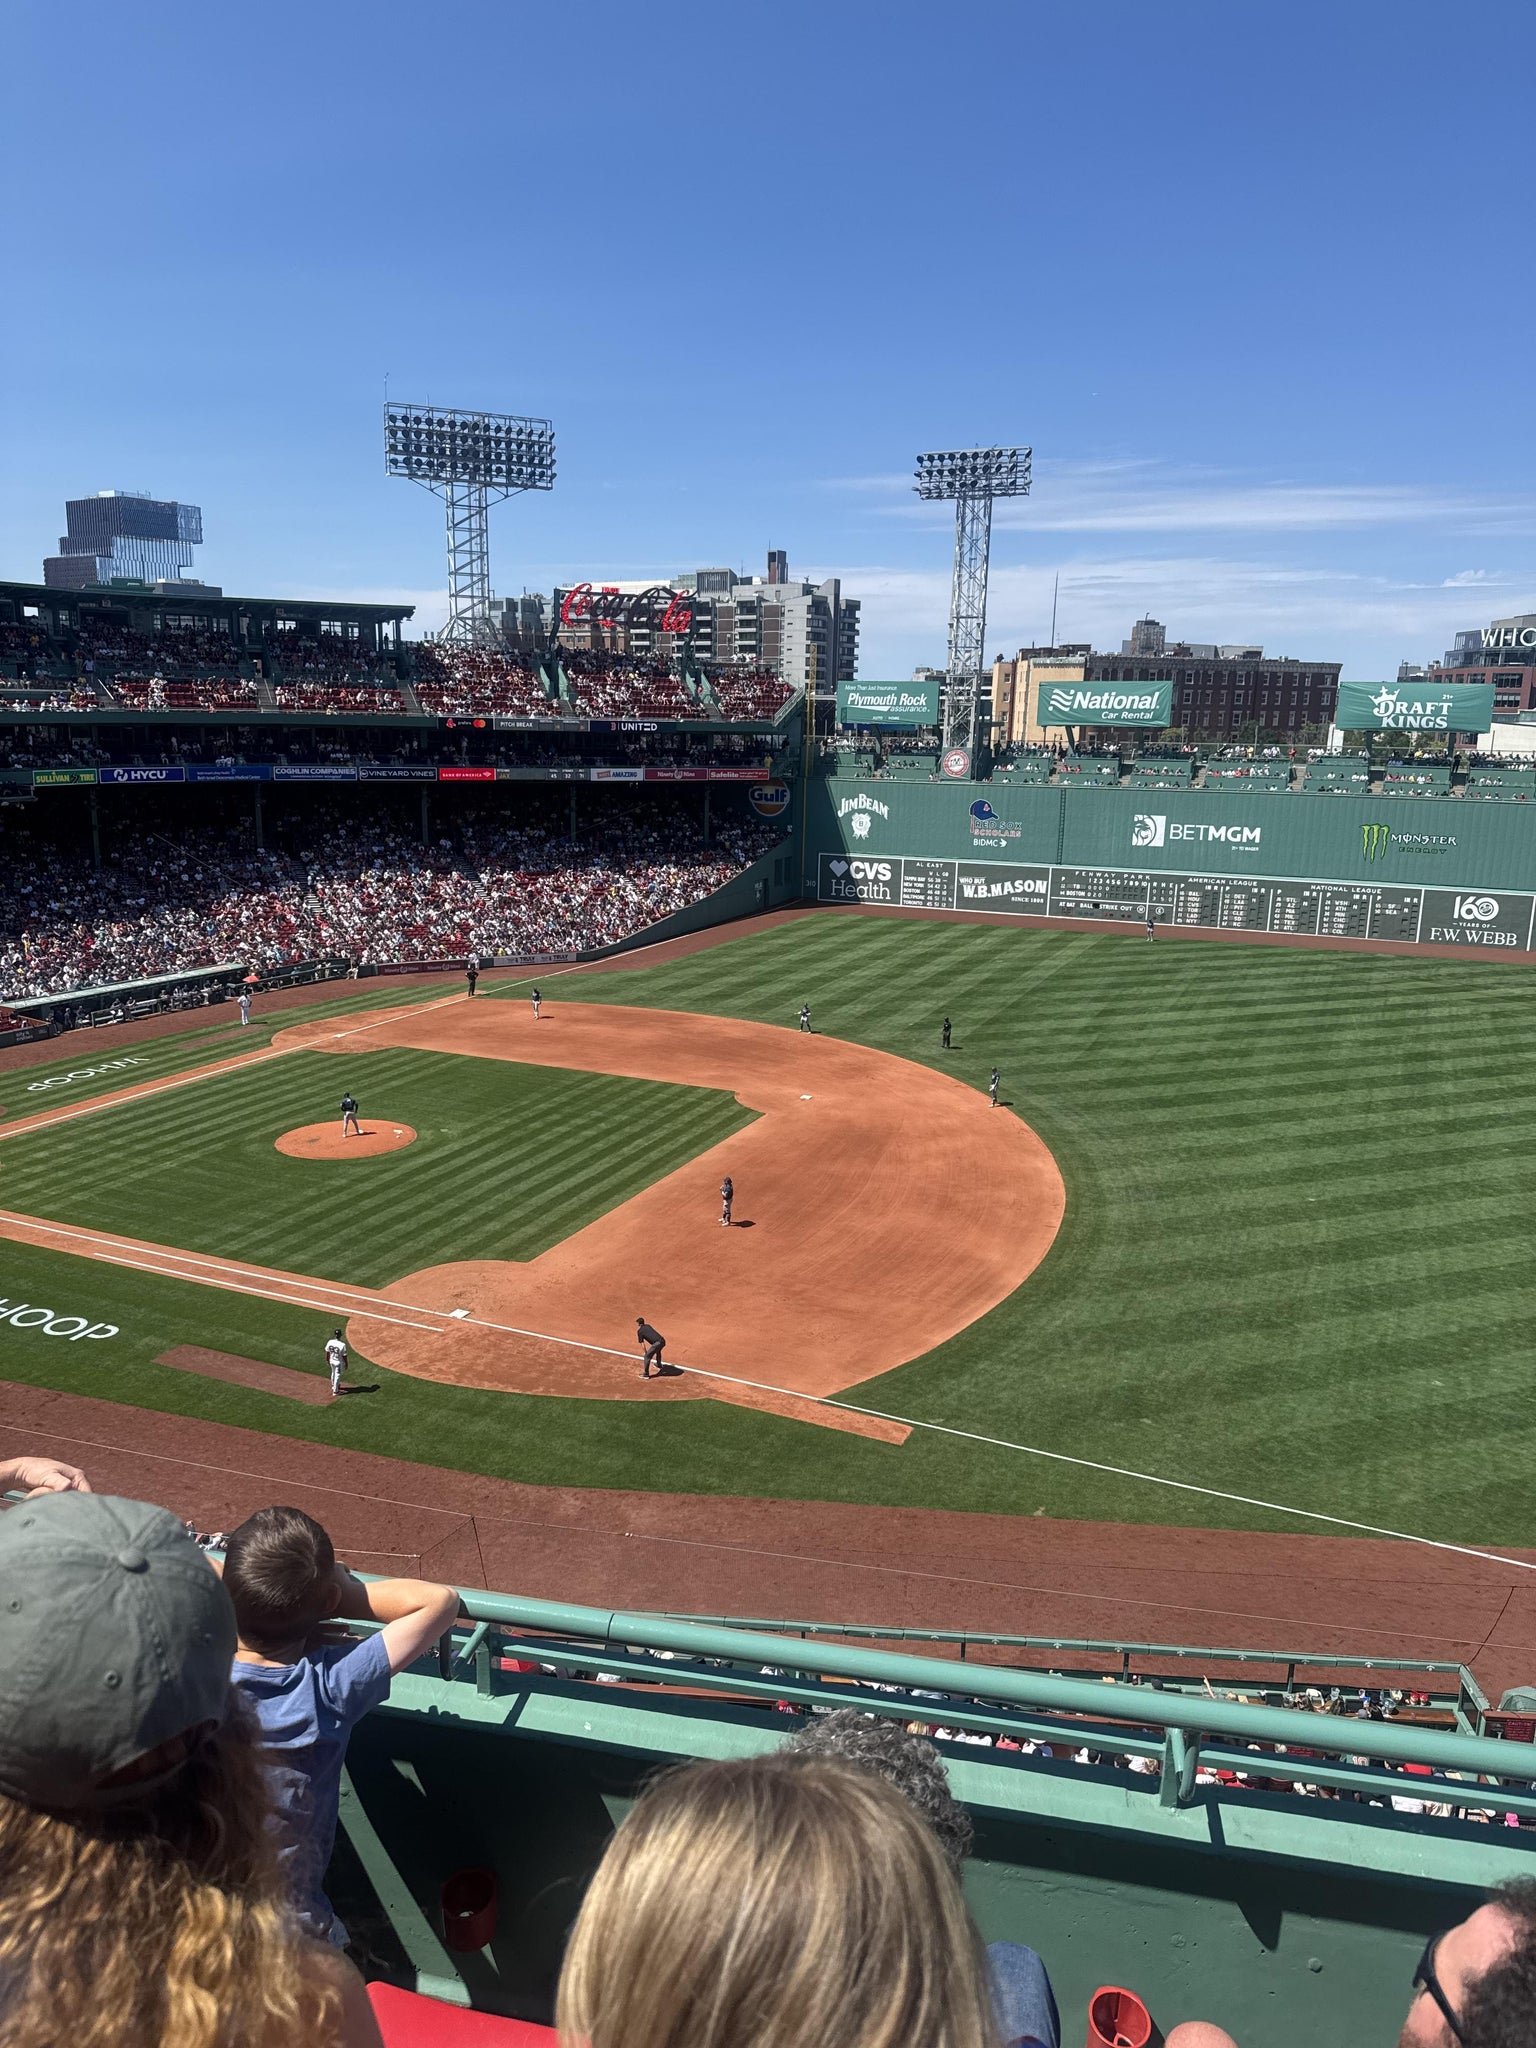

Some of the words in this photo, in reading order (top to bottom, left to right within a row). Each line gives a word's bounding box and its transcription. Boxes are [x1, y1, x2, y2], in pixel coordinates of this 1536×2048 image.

[848, 692, 896, 707] Plymouth
[899, 693, 927, 706] Rock
[1072, 692, 1158, 710] National
[1373, 700, 1452, 717] DRAFT
[1102, 712, 1118, 720] Car
[1120, 712, 1154, 720] Rental
[1381, 716, 1448, 729] KINGS
[621, 723, 658, 731] UNITED
[36, 773, 70, 783] SULLIVAN
[131, 770, 167, 780] HYCU
[752, 788, 788, 802] Gulf
[838, 798, 858, 818] JIM
[858, 794, 890, 820] BEAM
[975, 820, 996, 828] RED
[1000, 822, 1022, 830] SOX
[974, 829, 1022, 837] SCHOLARS
[1170, 824, 1261, 844] BETMGM
[1391, 833, 1457, 846] MONSTER
[973, 838, 998, 846] BIDMC
[850, 861, 892, 881] CVS
[830, 880, 891, 900] Health
[1454, 896, 1499, 921] 160
[1430, 928, 1460, 942] F.W.
[1465, 930, 1518, 946] WEBB
[27, 1058, 150, 1090] WHOOP
